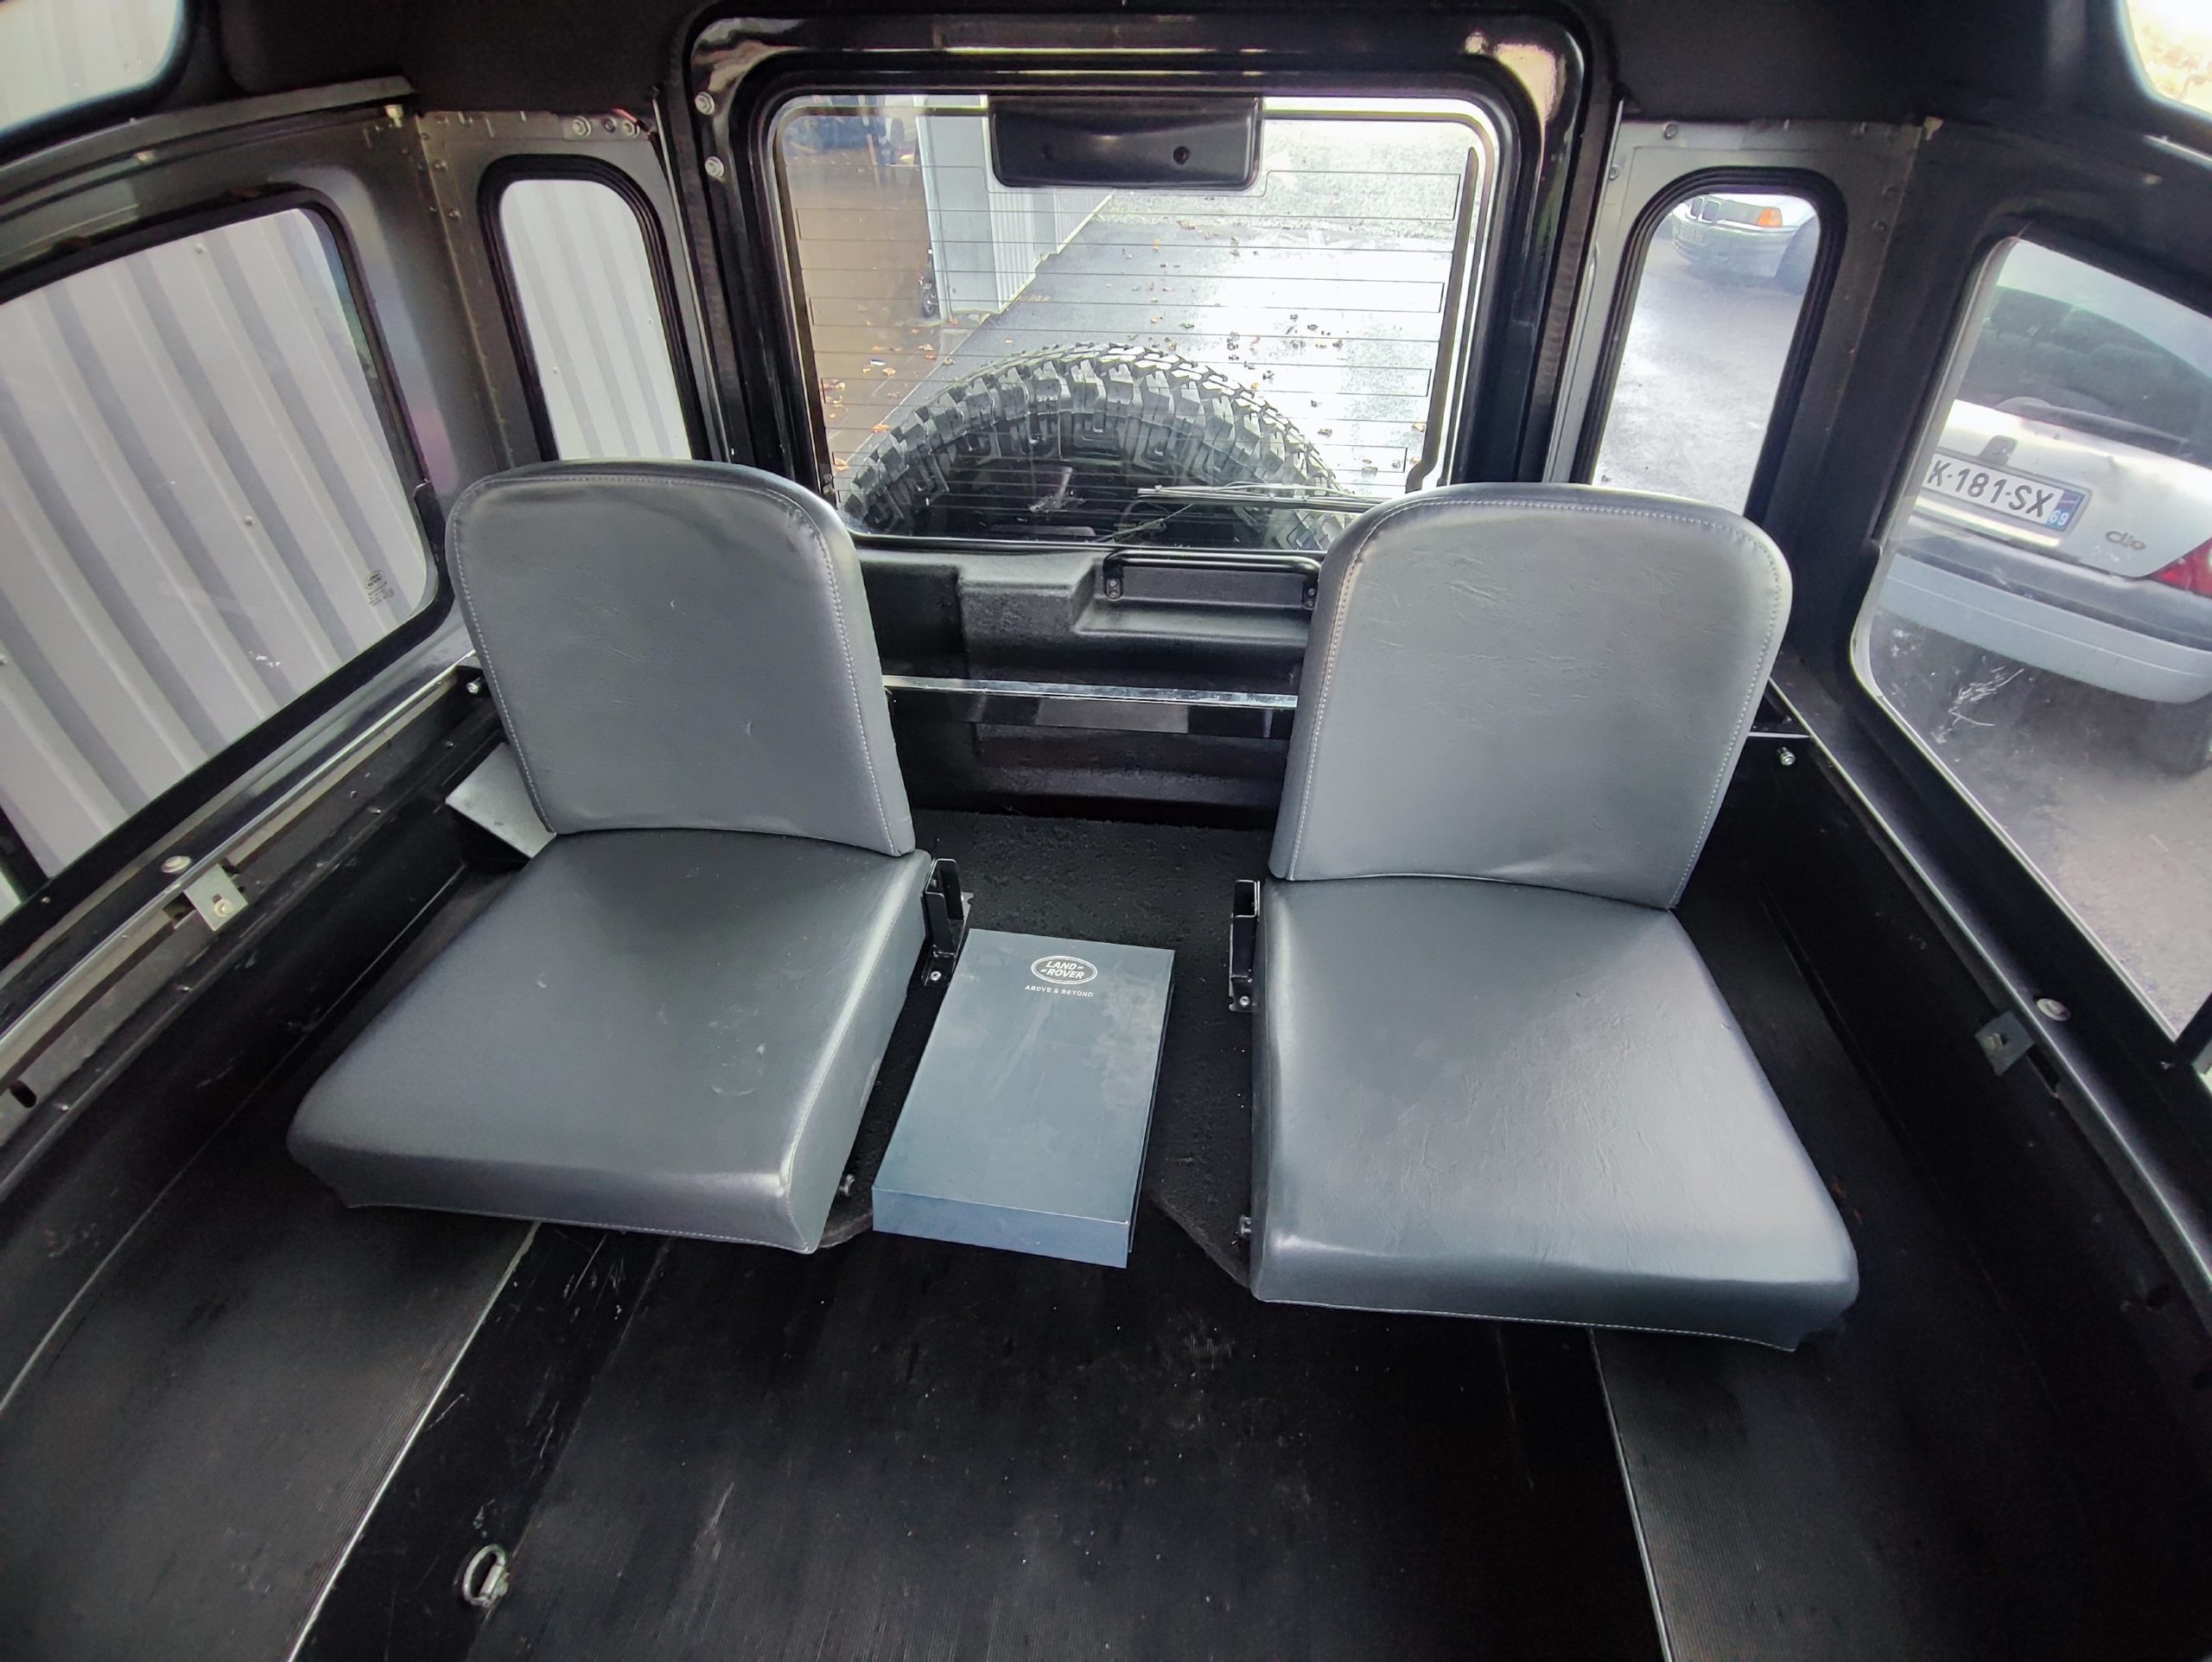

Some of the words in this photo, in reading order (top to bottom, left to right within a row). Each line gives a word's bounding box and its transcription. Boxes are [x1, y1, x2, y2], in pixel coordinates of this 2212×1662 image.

[2049, 509, 2069, 526] 69
[1046, 961, 1077, 970] LAND
[1046, 969, 1084, 978] ROVER
[1024, 984, 1052, 993] ABOVE
[1061, 989, 1094, 997] BEYOND
